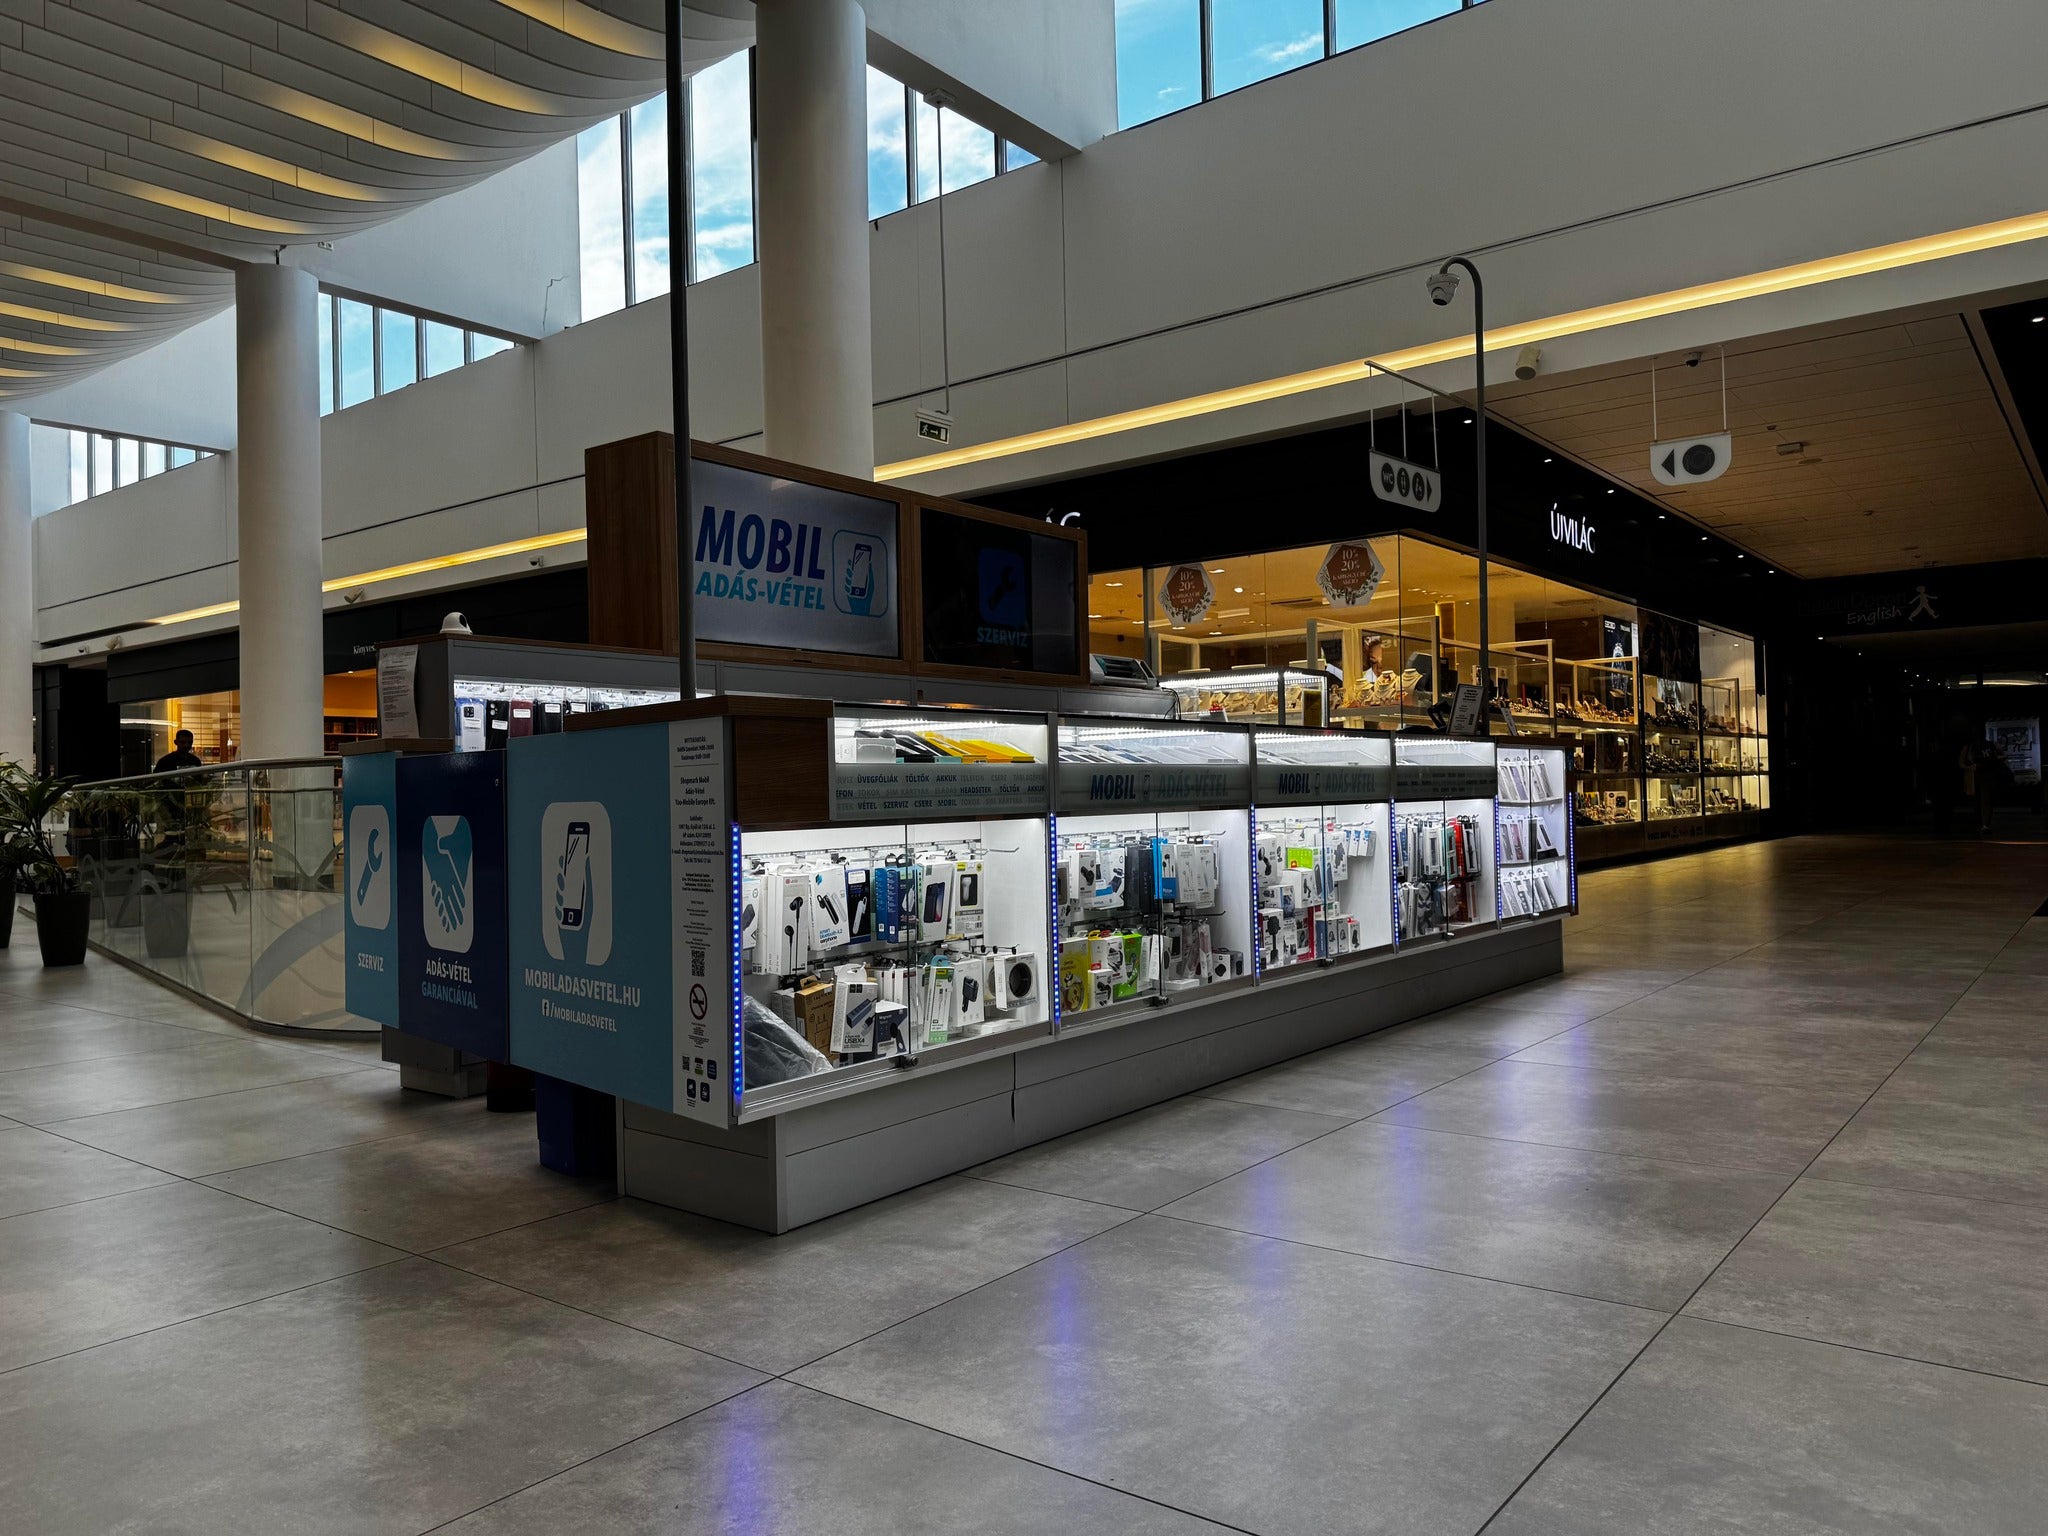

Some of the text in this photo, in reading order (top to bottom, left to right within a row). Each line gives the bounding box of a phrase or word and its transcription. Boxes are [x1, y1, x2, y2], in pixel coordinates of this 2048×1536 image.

[695, 505, 826, 581] MOBIL
[695, 570, 826, 611] ADÁS-VÉTEL
[1847, 605, 1902, 626] English
[976, 625, 1029, 648] SZERVIZ
[857, 773, 898, 784] ÜVEGFÓLIÁK
[936, 774, 958, 783] AKKUK
[1090, 769, 1229, 800] MOBIL ADÁS-VÉTEL
[1279, 773, 1310, 795] MOBIL
[857, 800, 877, 810] VÉTEL
[883, 800, 909, 809] SZERVIZ
[914, 799, 933, 808] CSERE
[357, 952, 385, 973] SZERVIZ
[425, 957, 473, 985] ADÁS-VÉTEL
[421, 980, 479, 1010] GARANCIÁVAL
[525, 968, 641, 1008] MOBILADASVETEL.HU
